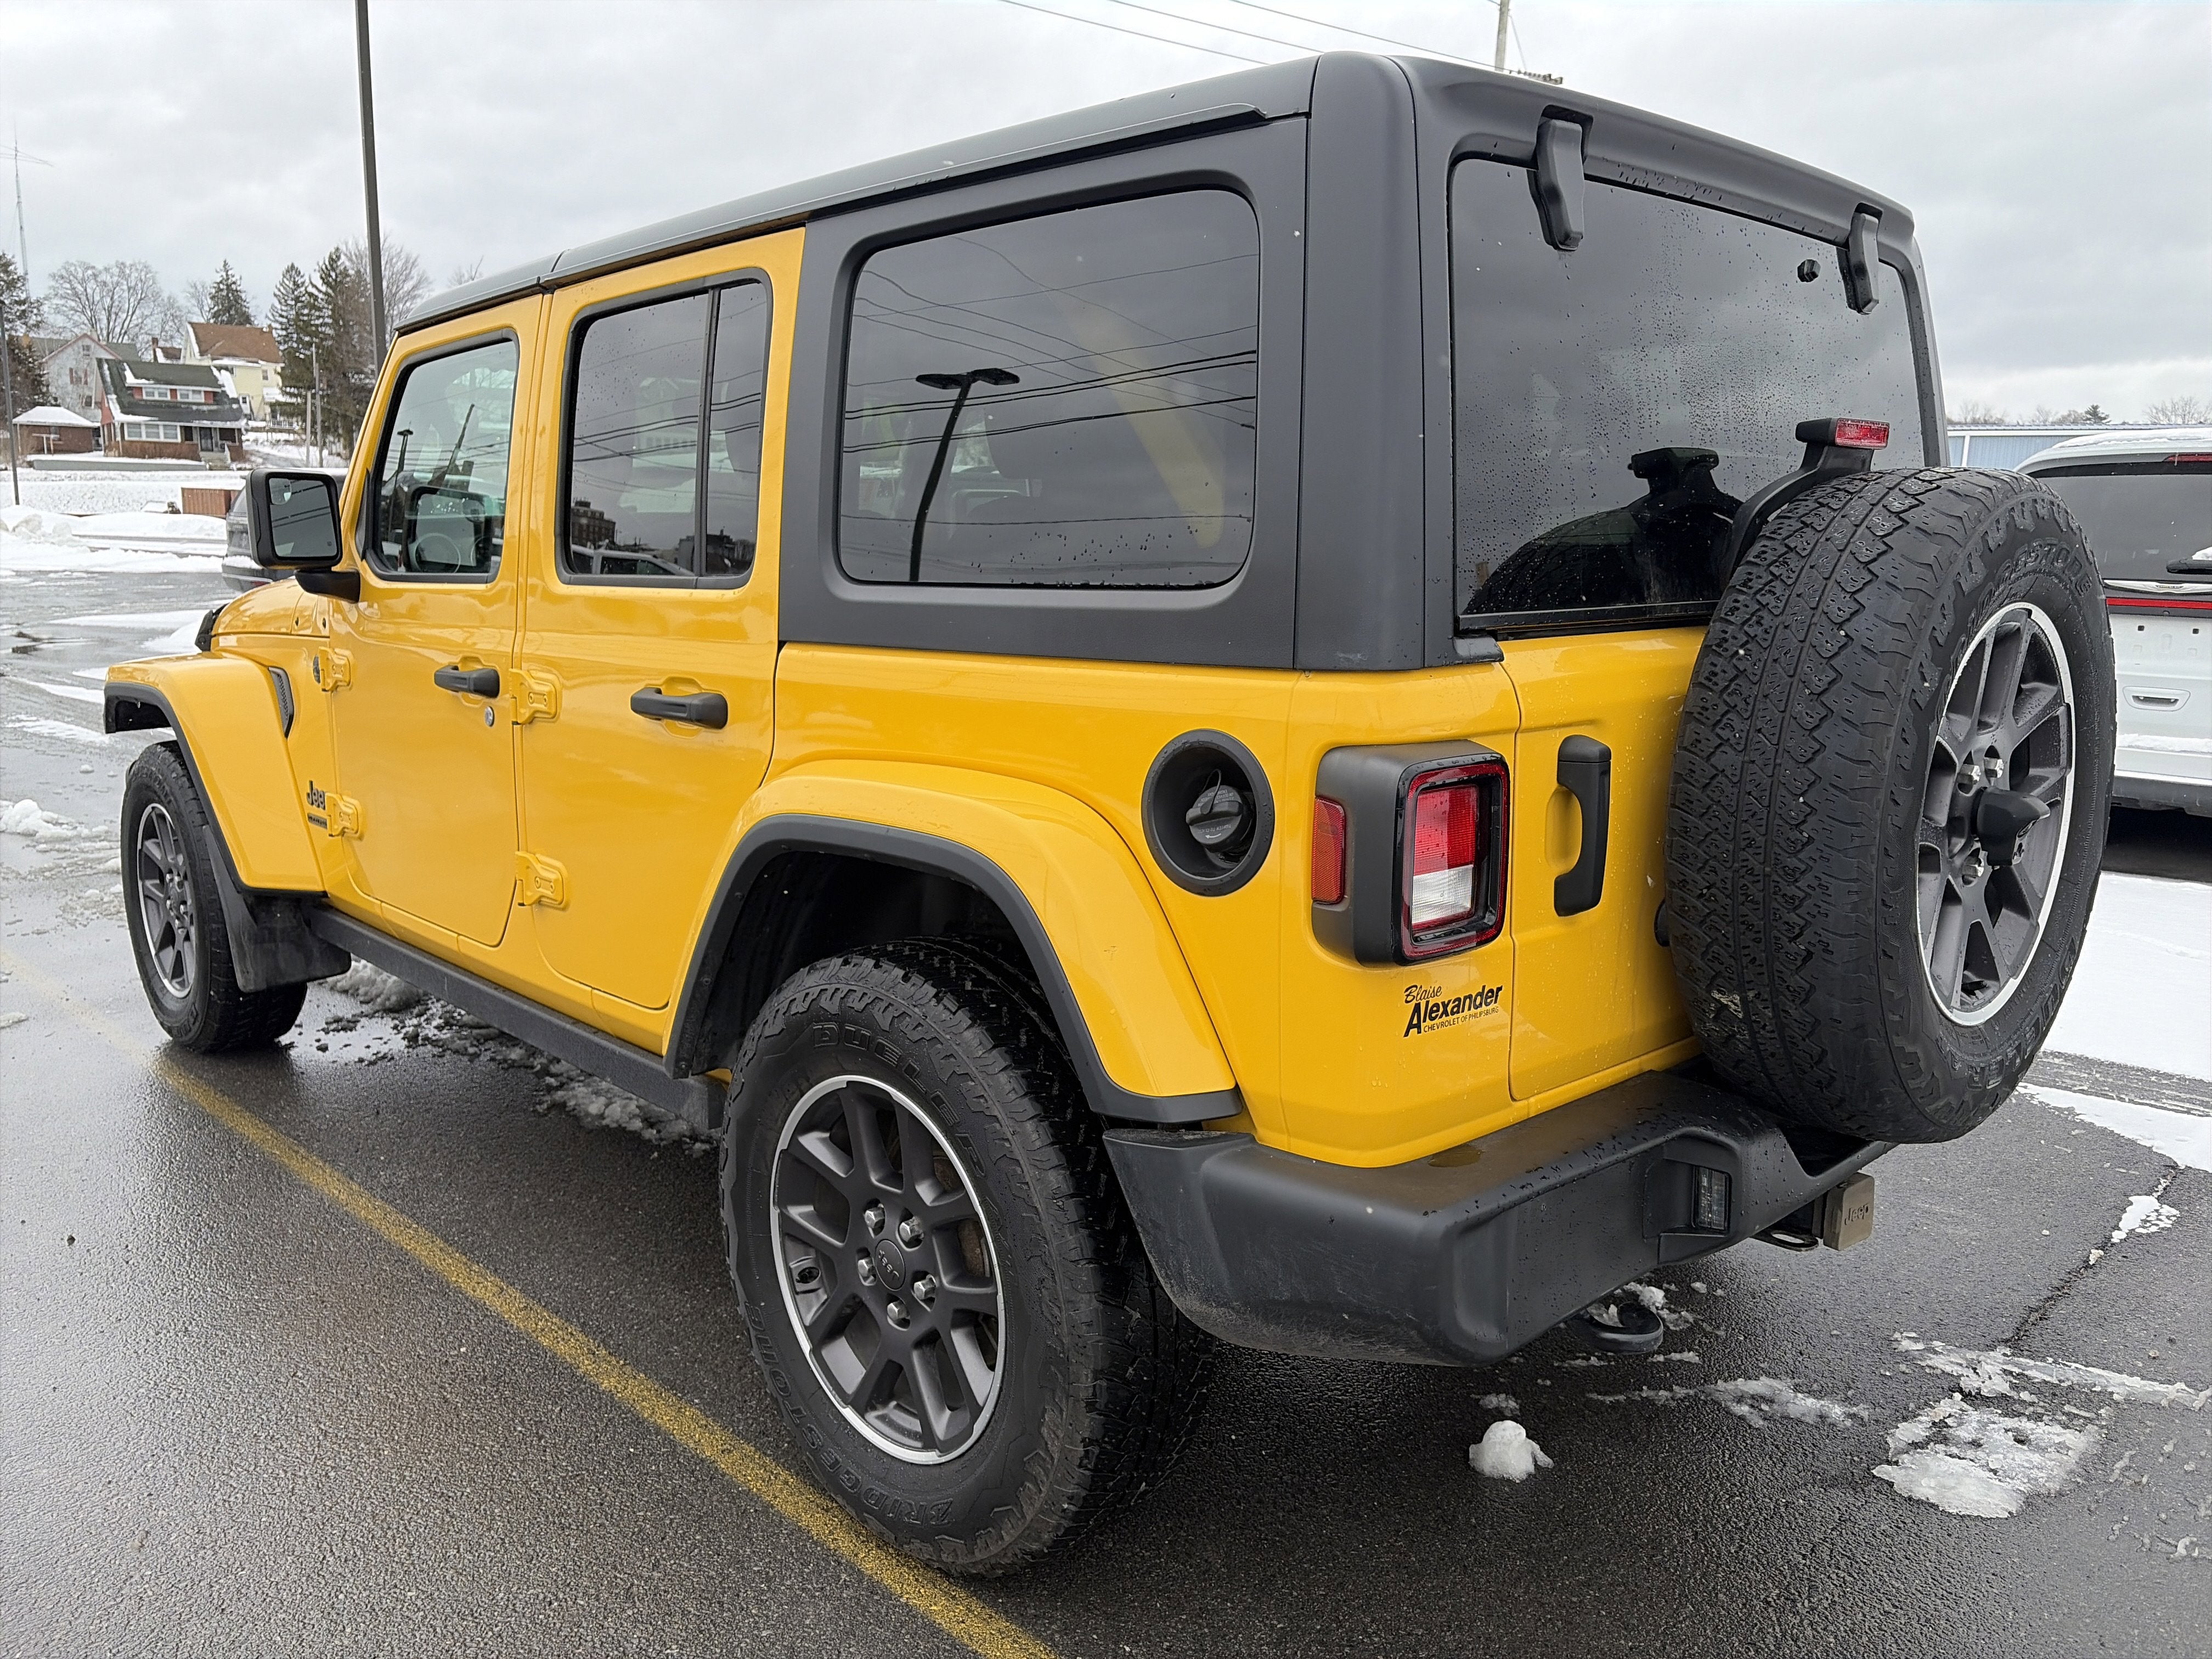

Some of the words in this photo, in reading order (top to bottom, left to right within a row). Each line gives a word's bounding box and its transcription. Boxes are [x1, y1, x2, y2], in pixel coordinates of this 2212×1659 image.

[306, 780, 326, 810] Jee
[1404, 984, 1442, 1003] Blaise
[1403, 985, 1503, 1038] Alexander
[1423, 1017, 1460, 1033] CHEVROLET
[1460, 1014, 1468, 1023] OF
[1468, 1006, 1499, 1021] PHILIPSBURG
[813, 1022, 986, 1178] DUELER
[1844, 1203, 1869, 1225] Jeep
[878, 1249, 900, 1279] Jeep
[744, 1301, 953, 1528] BRIDGESTONE
